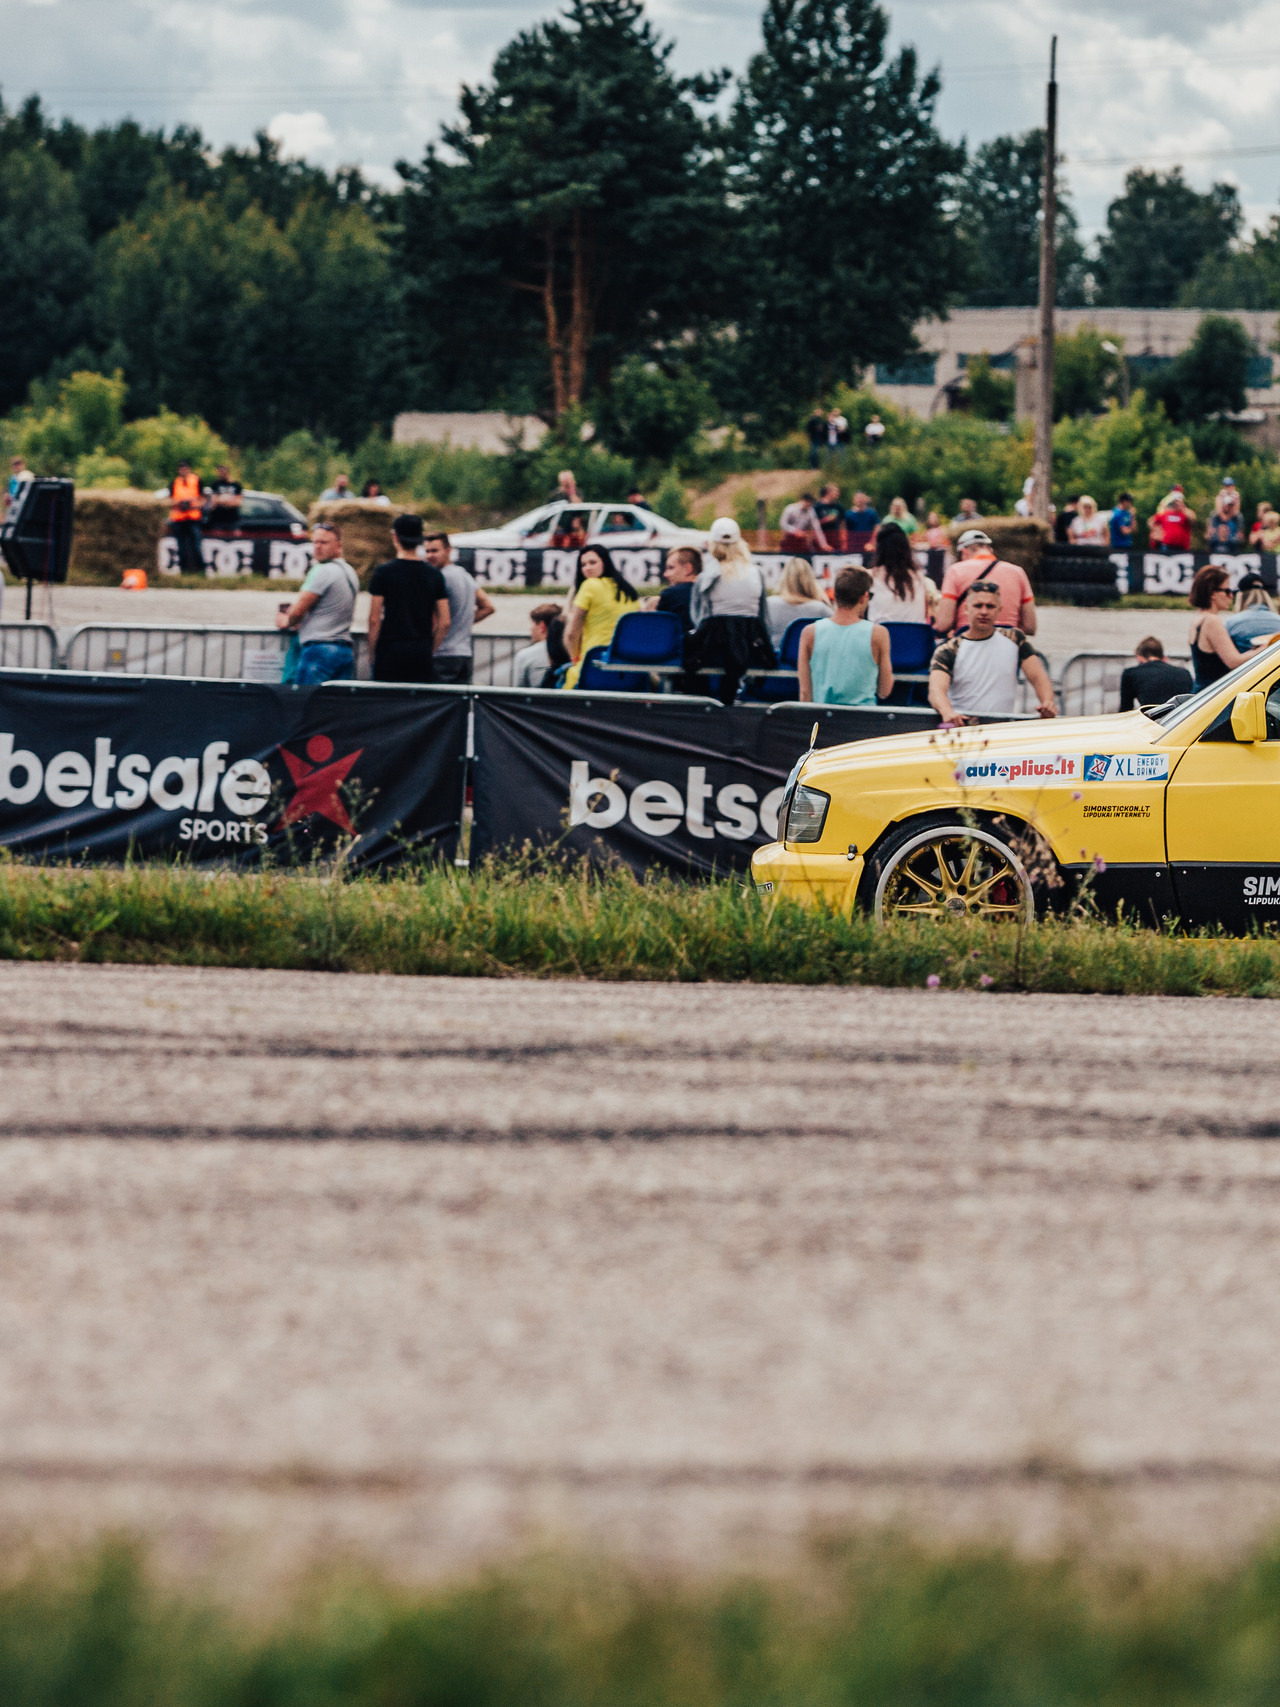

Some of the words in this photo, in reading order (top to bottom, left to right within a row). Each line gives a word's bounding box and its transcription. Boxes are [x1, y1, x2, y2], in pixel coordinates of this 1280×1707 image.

[1137, 757, 1165, 767] ENERGY
[0, 732, 271, 816] betsafe
[1136, 767, 1157, 776] DRINK
[179, 818, 268, 844] SPORTS
